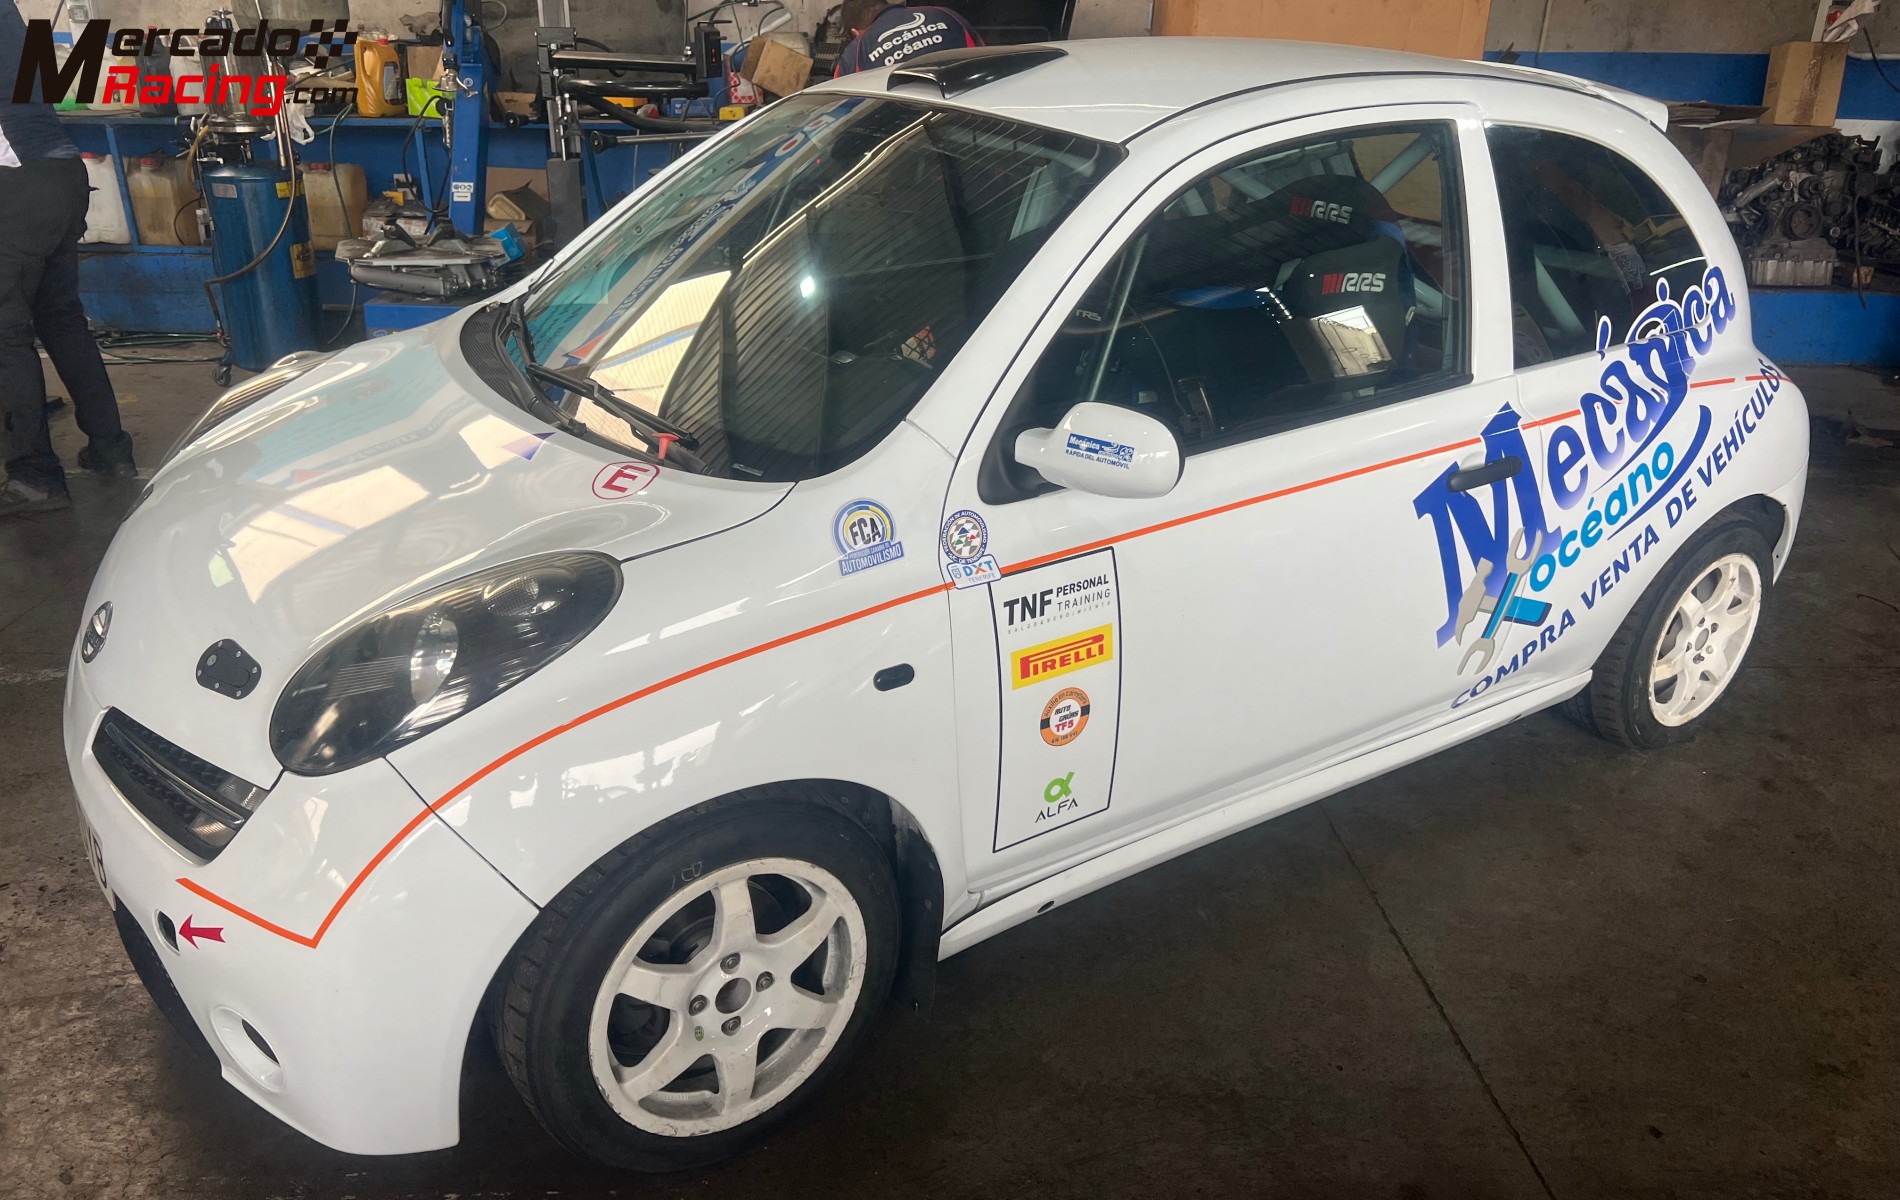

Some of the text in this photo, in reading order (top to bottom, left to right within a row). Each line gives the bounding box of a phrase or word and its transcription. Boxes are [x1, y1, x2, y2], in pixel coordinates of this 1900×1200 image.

[868, 22, 948, 62] mecánica
[884, 34, 943, 66] océano
[1341, 272, 1386, 293] RRS
[1413, 266, 1736, 649] Mecánica
[601, 465, 650, 493] E
[849, 517, 881, 546] FCA
[1529, 442, 1674, 592] océano
[1451, 358, 1782, 709] COMPRA VENTA DE VEHÍCULOS
[841, 543, 902, 574] AUTOMOVILISMO
[962, 560, 993, 577] DXT
[968, 573, 997, 583] TENERIFE
[1056, 574, 1109, 597] PERSONAL
[1003, 589, 1053, 626] TNF
[1057, 589, 1111, 611] TRAINING
[1020, 634, 1104, 680] PIRELLI
[1035, 797, 1078, 823] ALFA
